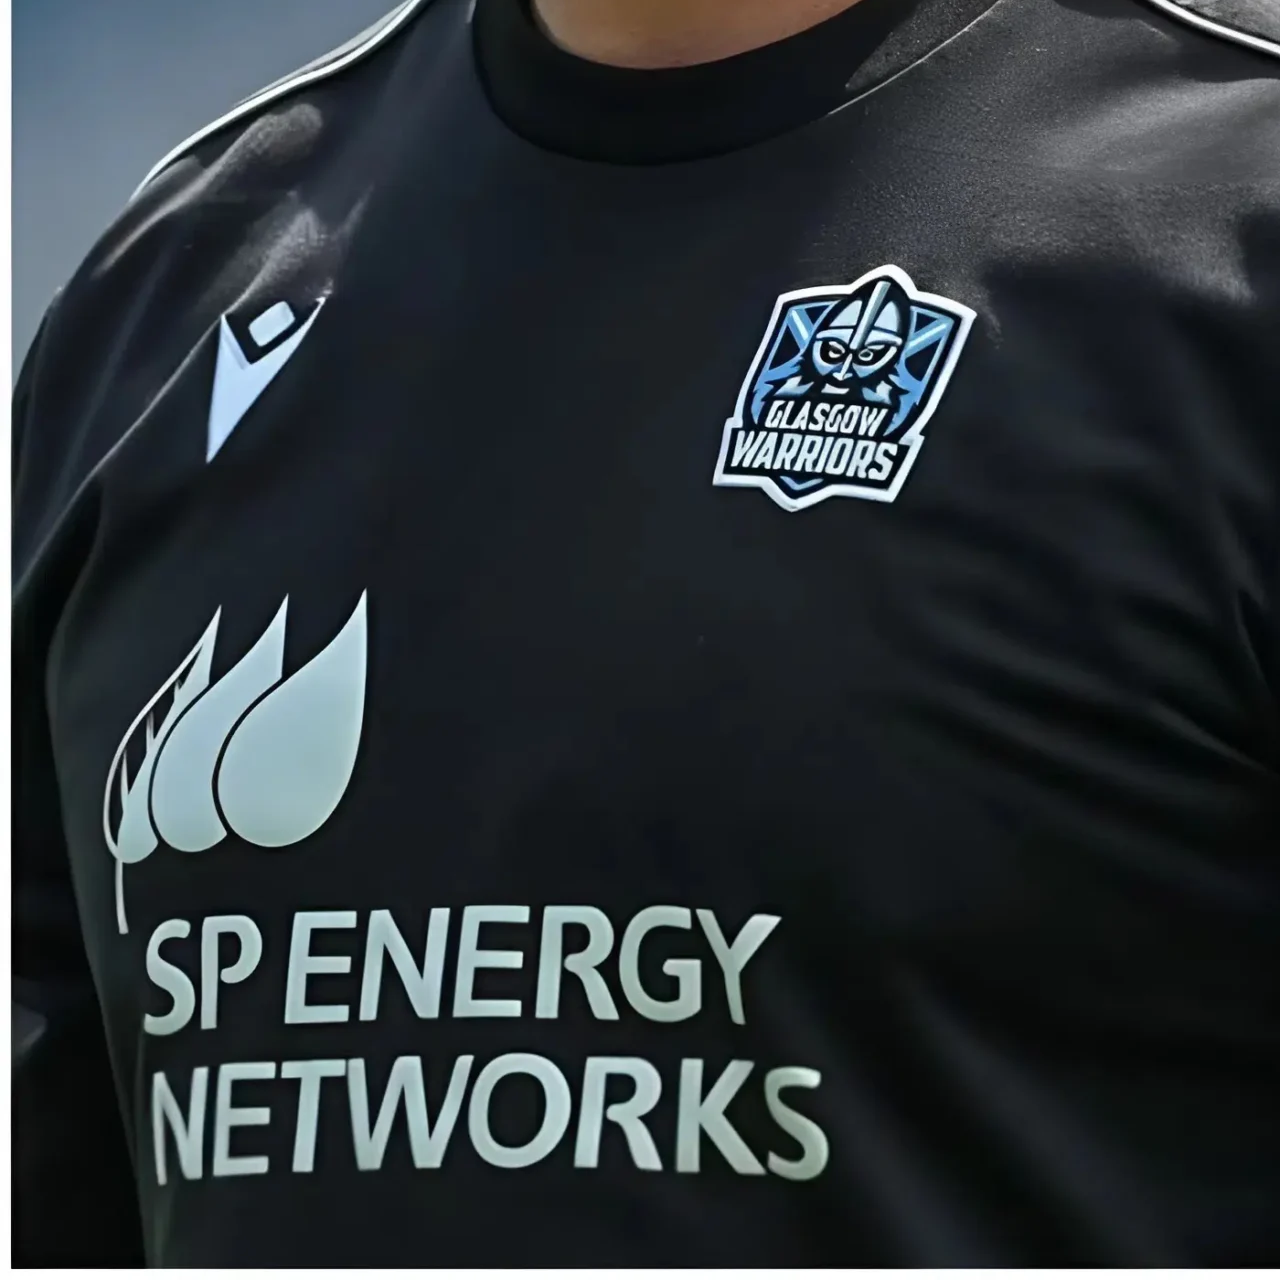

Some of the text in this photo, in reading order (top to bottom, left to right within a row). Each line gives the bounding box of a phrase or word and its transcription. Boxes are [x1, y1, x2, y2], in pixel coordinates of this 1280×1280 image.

[730, 430, 899, 481] WARRIORS
[764, 400, 889, 437] GLASGOW
[143, 904, 783, 1036] SP ENERGY
[150, 1052, 830, 1187] NETWORKS
